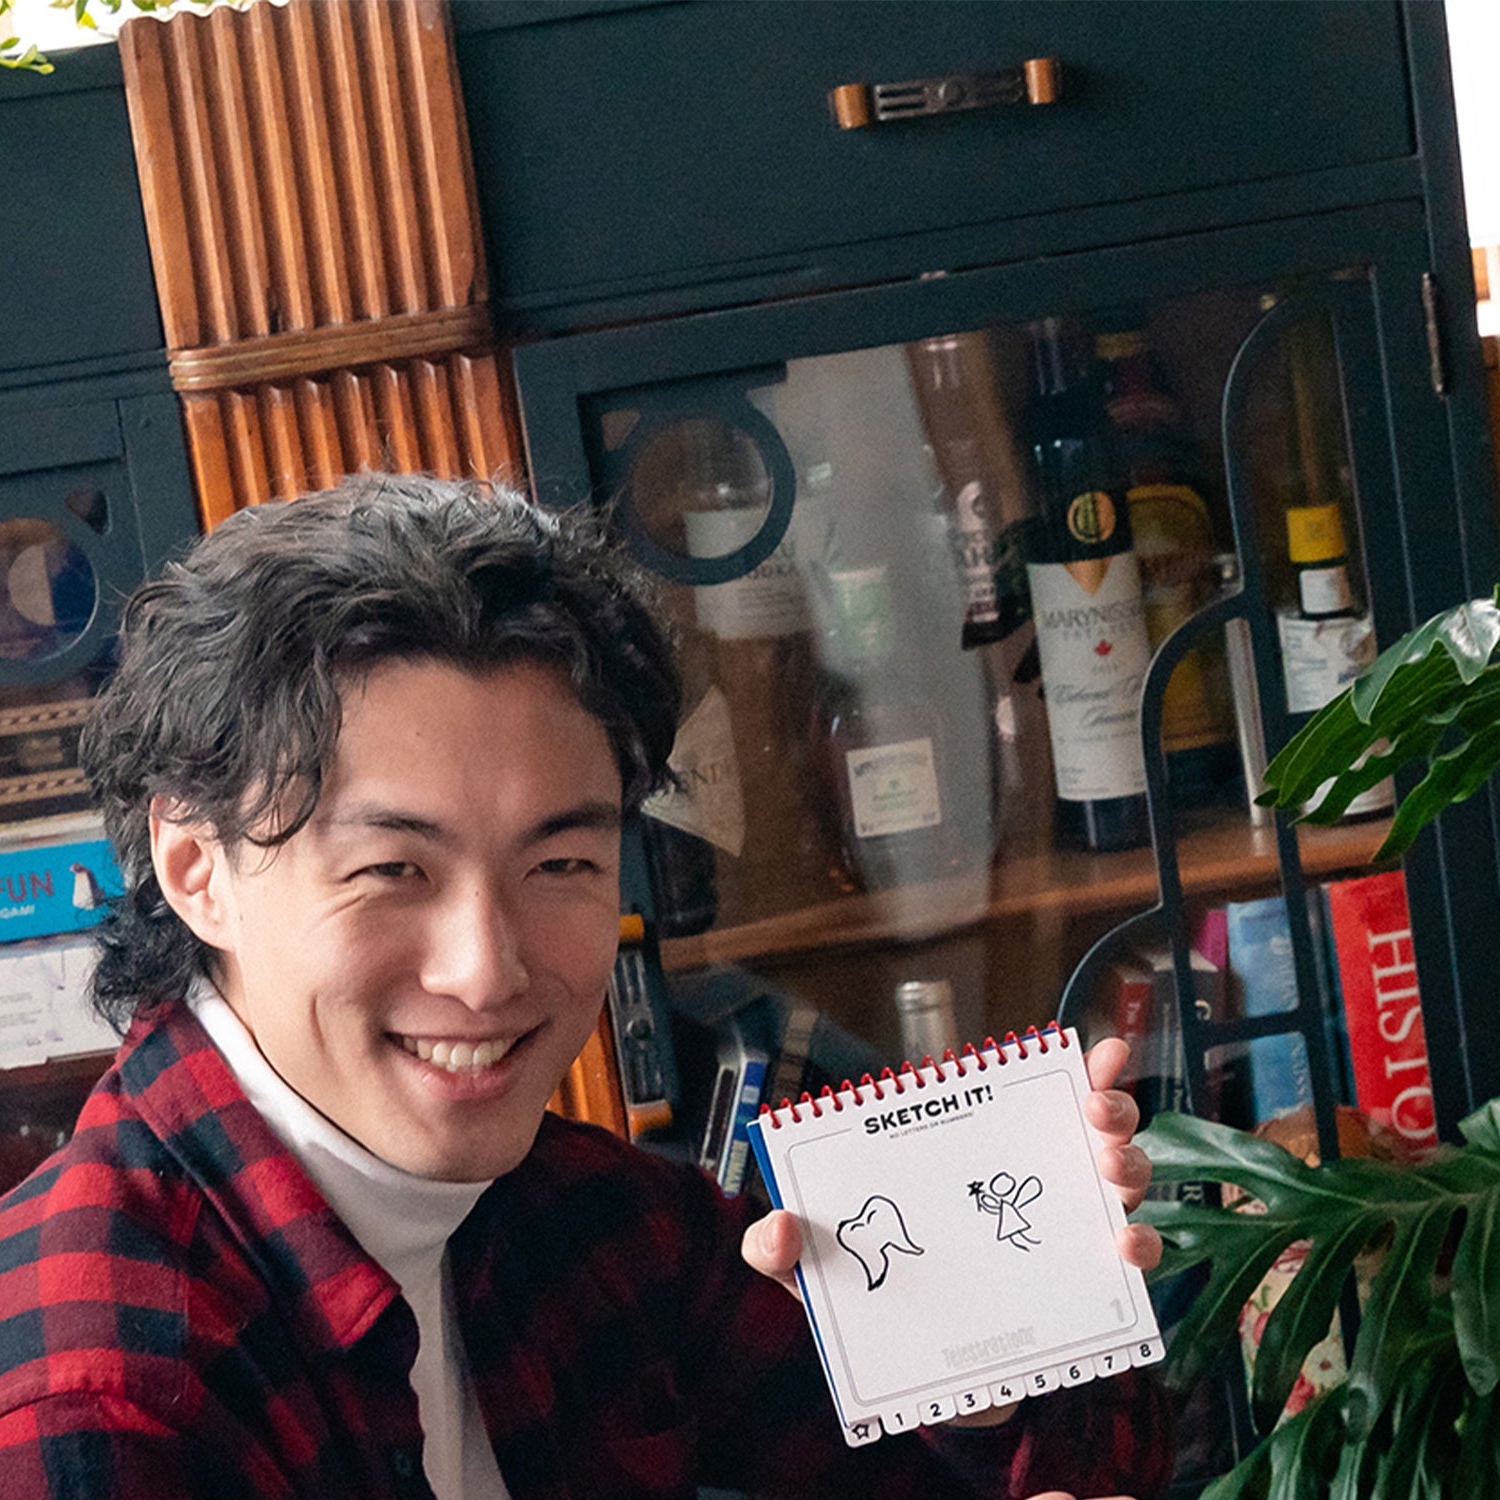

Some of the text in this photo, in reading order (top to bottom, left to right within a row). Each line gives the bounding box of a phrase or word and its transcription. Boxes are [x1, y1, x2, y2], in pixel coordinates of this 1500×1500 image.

[864, 1084, 994, 1135] SKETCH IT!
[1109, 1297, 1125, 1323] 1
[941, 1325, 1036, 1368] Telestrations
[895, 1343, 1151, 1426] 1 2 3 4 5 6 7 8
